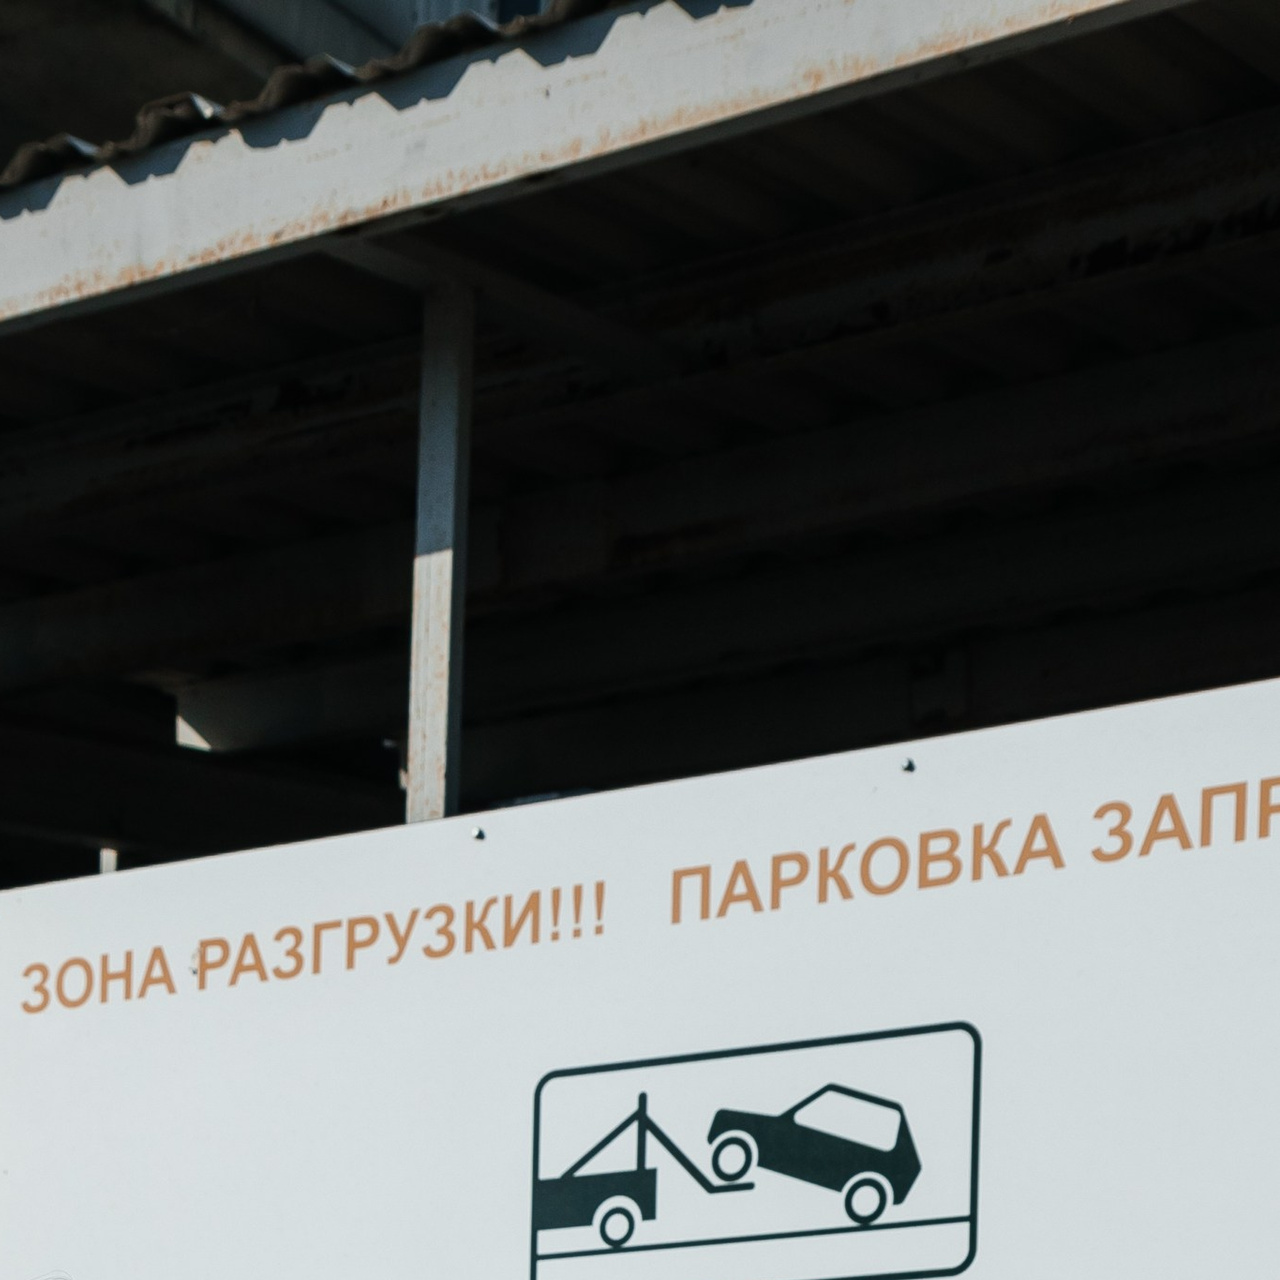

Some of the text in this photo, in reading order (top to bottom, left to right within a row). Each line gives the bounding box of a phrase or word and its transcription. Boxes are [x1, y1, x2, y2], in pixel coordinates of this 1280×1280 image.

[21, 946, 176, 1014] ЗОНА
[197, 881, 605, 990] РАЗГРУЗКИ!!!
[671, 813, 1065, 924] ПАРКОВКА
